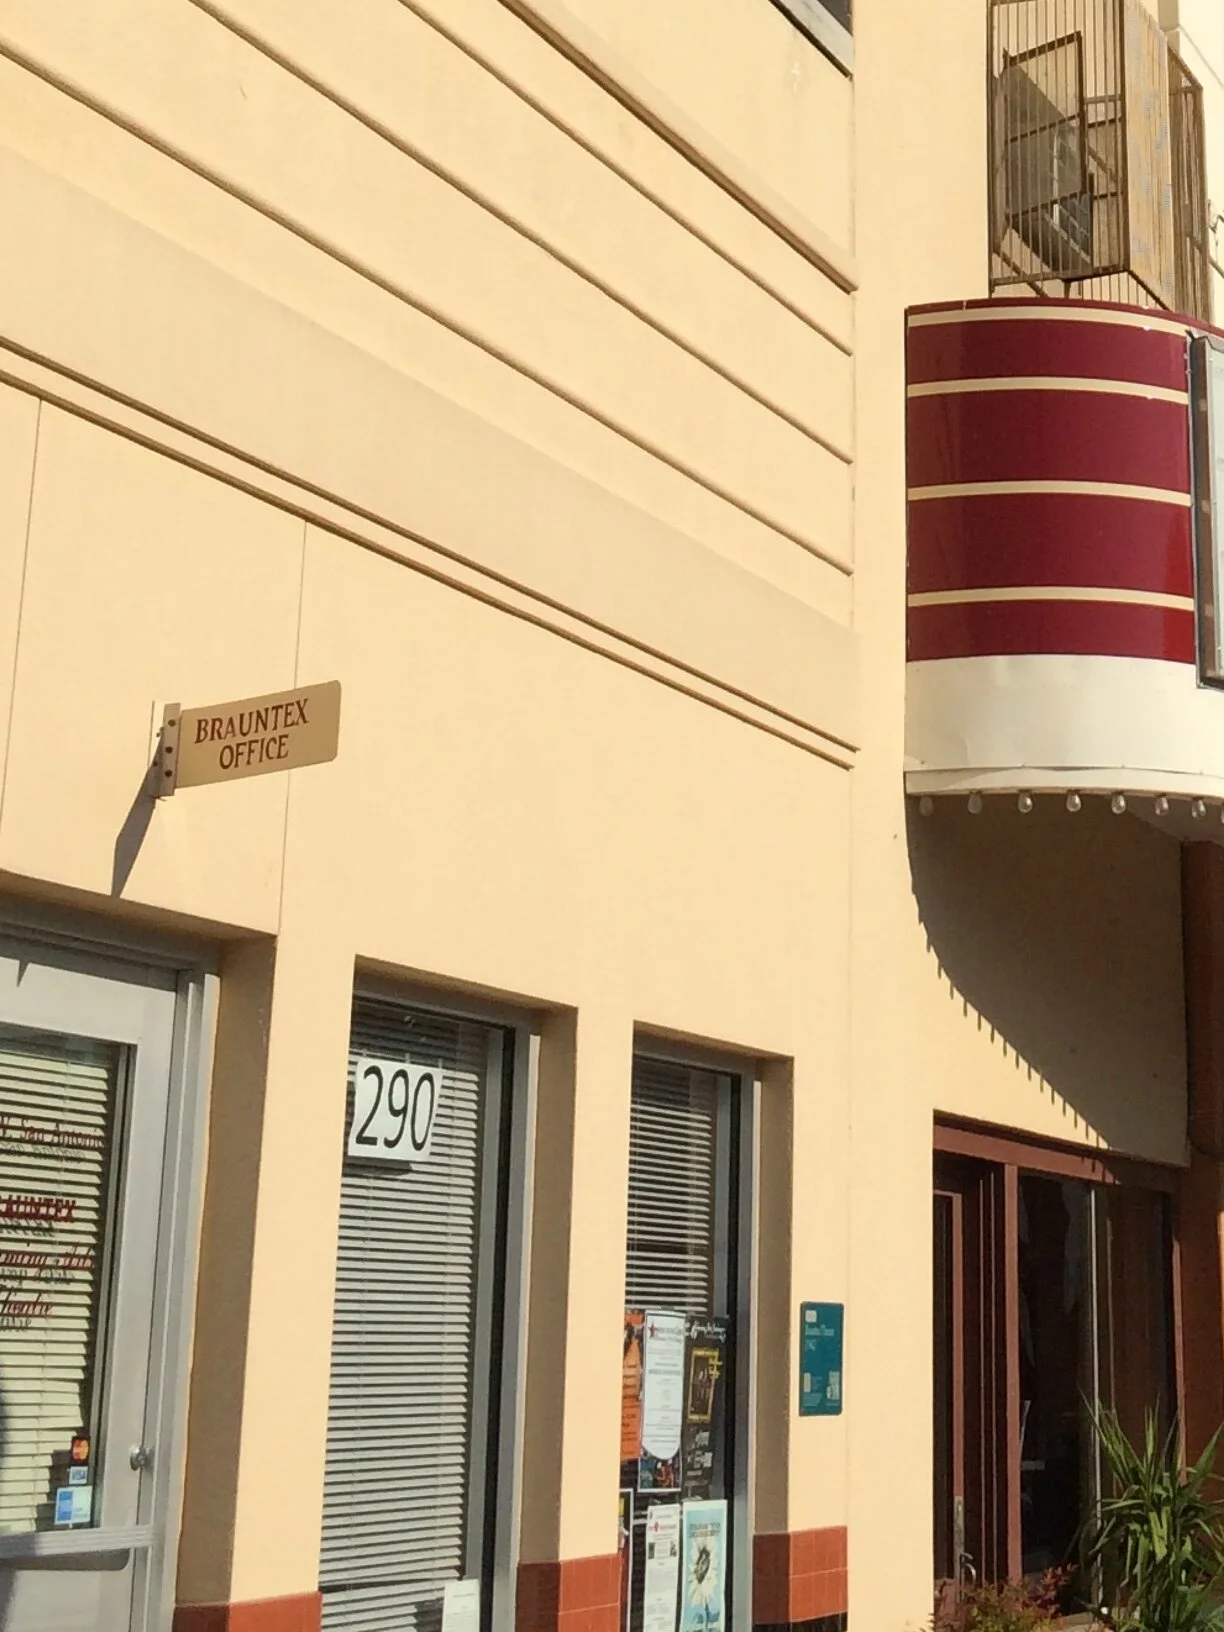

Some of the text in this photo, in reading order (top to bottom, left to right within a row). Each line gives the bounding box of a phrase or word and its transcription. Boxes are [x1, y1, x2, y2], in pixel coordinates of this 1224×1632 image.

[194, 698, 309, 744] BRAUNTEX
[219, 734, 289, 769] OFFICE
[356, 1065, 435, 1151] 290
